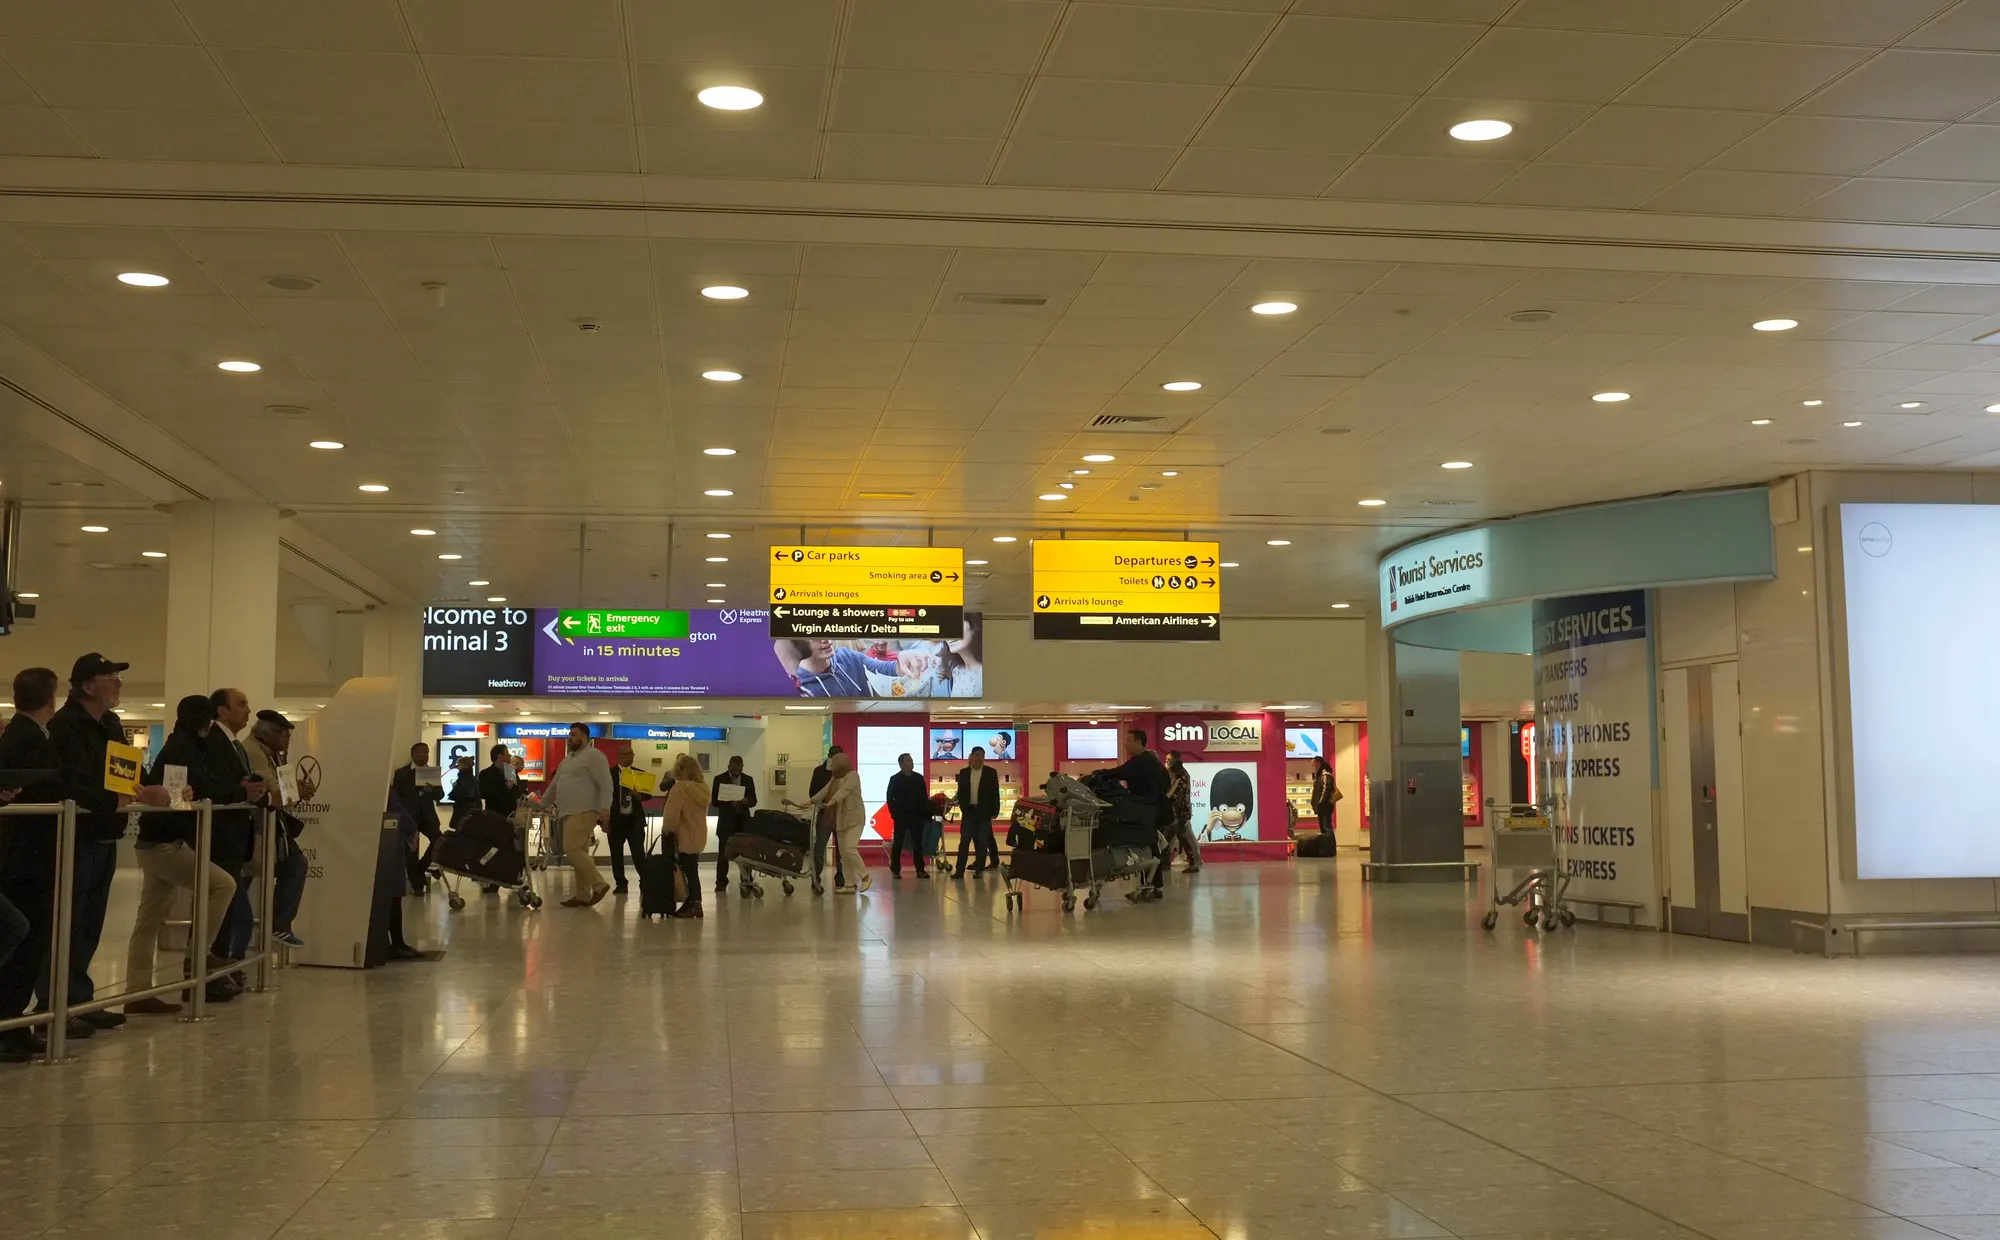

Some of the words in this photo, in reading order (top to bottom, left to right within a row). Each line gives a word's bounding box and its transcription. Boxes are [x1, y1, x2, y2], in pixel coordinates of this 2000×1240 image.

[807, 550, 827, 560] Car
[829, 550, 860, 562] parks
[1114, 555, 1182, 567] Departures
[1398, 561, 1426, 586] Tourist
[1429, 551, 1483, 577] Services
[869, 571, 907, 581] Smoking
[1119, 577, 1149, 586] Toilets
[1452, 583, 1471, 593] Centre
[790, 590, 823, 598] Arrivals
[825, 590, 860, 600] lounges
[1054, 597, 1090, 606] Arrivals
[1091, 597, 1124, 607] lounge
[423, 607, 496, 625] lcome
[503, 607, 528, 625] to
[606, 613, 661, 625] Emergency
[792, 608, 830, 619] Lounge
[832, 608, 841, 617] &
[843, 608, 885, 617] showers
[1115, 615, 1161, 625] American
[1163, 615, 1199, 625] Airlines
[1557, 604, 1633, 643] SERVICES
[606, 623, 626, 633] exit
[791, 623, 822, 635] Virgin
[824, 623, 863, 633] Atlantic
[870, 624, 897, 634] Delta
[423, 630, 488, 651] minal
[494, 631, 509, 651] 3
[689, 630, 717, 642] gton
[583, 645, 594, 656] in
[596, 645, 614, 657] 15
[617, 645, 681, 657] minutes
[488, 679, 527, 688] Heathrow
[547, 675, 561, 683] Buy
[516, 728, 551, 738] Currency
[648, 729, 671, 738] Currency
[671, 730, 695, 739] Exchange
[1163, 722, 1204, 742] sim
[1210, 726, 1259, 740] LOCAL
[1577, 721, 1631, 744] PHONES
[508, 747, 524, 756] CY?
[1571, 757, 1620, 778] EXPRESS
[1191, 780, 1207, 788] Talk
[1583, 825, 1635, 847] TICKETS
[1567, 858, 1617, 881] EXPRESS
